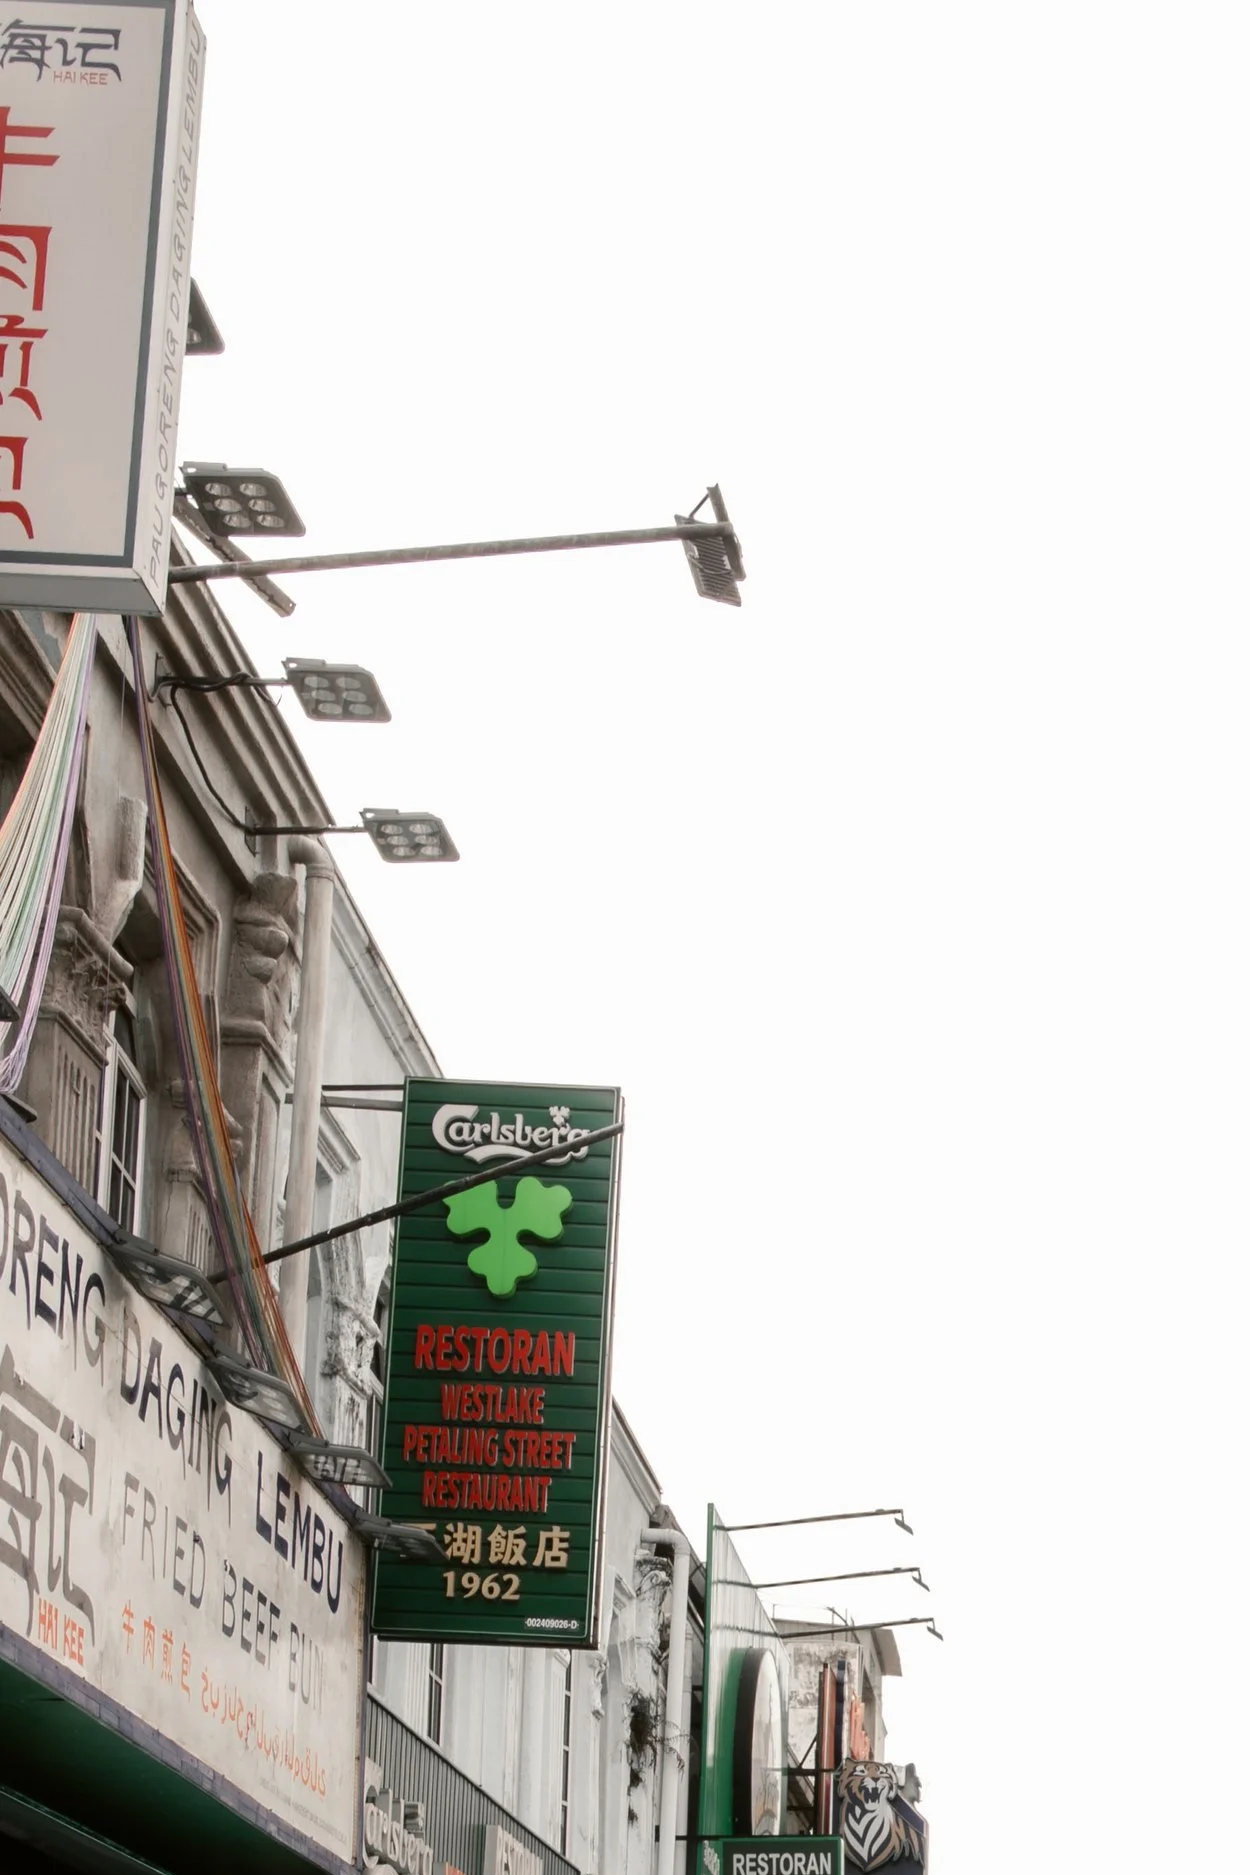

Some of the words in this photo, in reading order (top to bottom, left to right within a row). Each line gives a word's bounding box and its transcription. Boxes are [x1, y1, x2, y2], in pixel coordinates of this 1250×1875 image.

[53, 70, 76, 84] HAI
[79, 72, 109, 86] KEE
[156, 334, 181, 502] GORENG
[170, 166, 191, 321] DAGING
[181, 18, 201, 166] LEMBU
[432, 1104, 590, 1160] Carlsberg
[414, 1324, 576, 1376] RESTORAN
[441, 1383, 546, 1424] WESTLAKE
[121, 1305, 233, 1528] DAGING
[256, 1450, 344, 1614] LEMBU
[403, 1425, 499, 1467] PETALING
[503, 1429, 577, 1470] STREET
[422, 1469, 553, 1513] RESTAURANT
[401, 1522, 570, 1568] 湖飯店
[123, 1471, 207, 1609] FRIED
[222, 1558, 281, 1671] BEEF
[289, 1622, 324, 1715] BUN
[443, 1571, 521, 1600] 1962
[38, 1597, 59, 1650] HAI
[62, 1614, 85, 1667] KEE
[121, 1599, 191, 1702] 牛肉煎包
